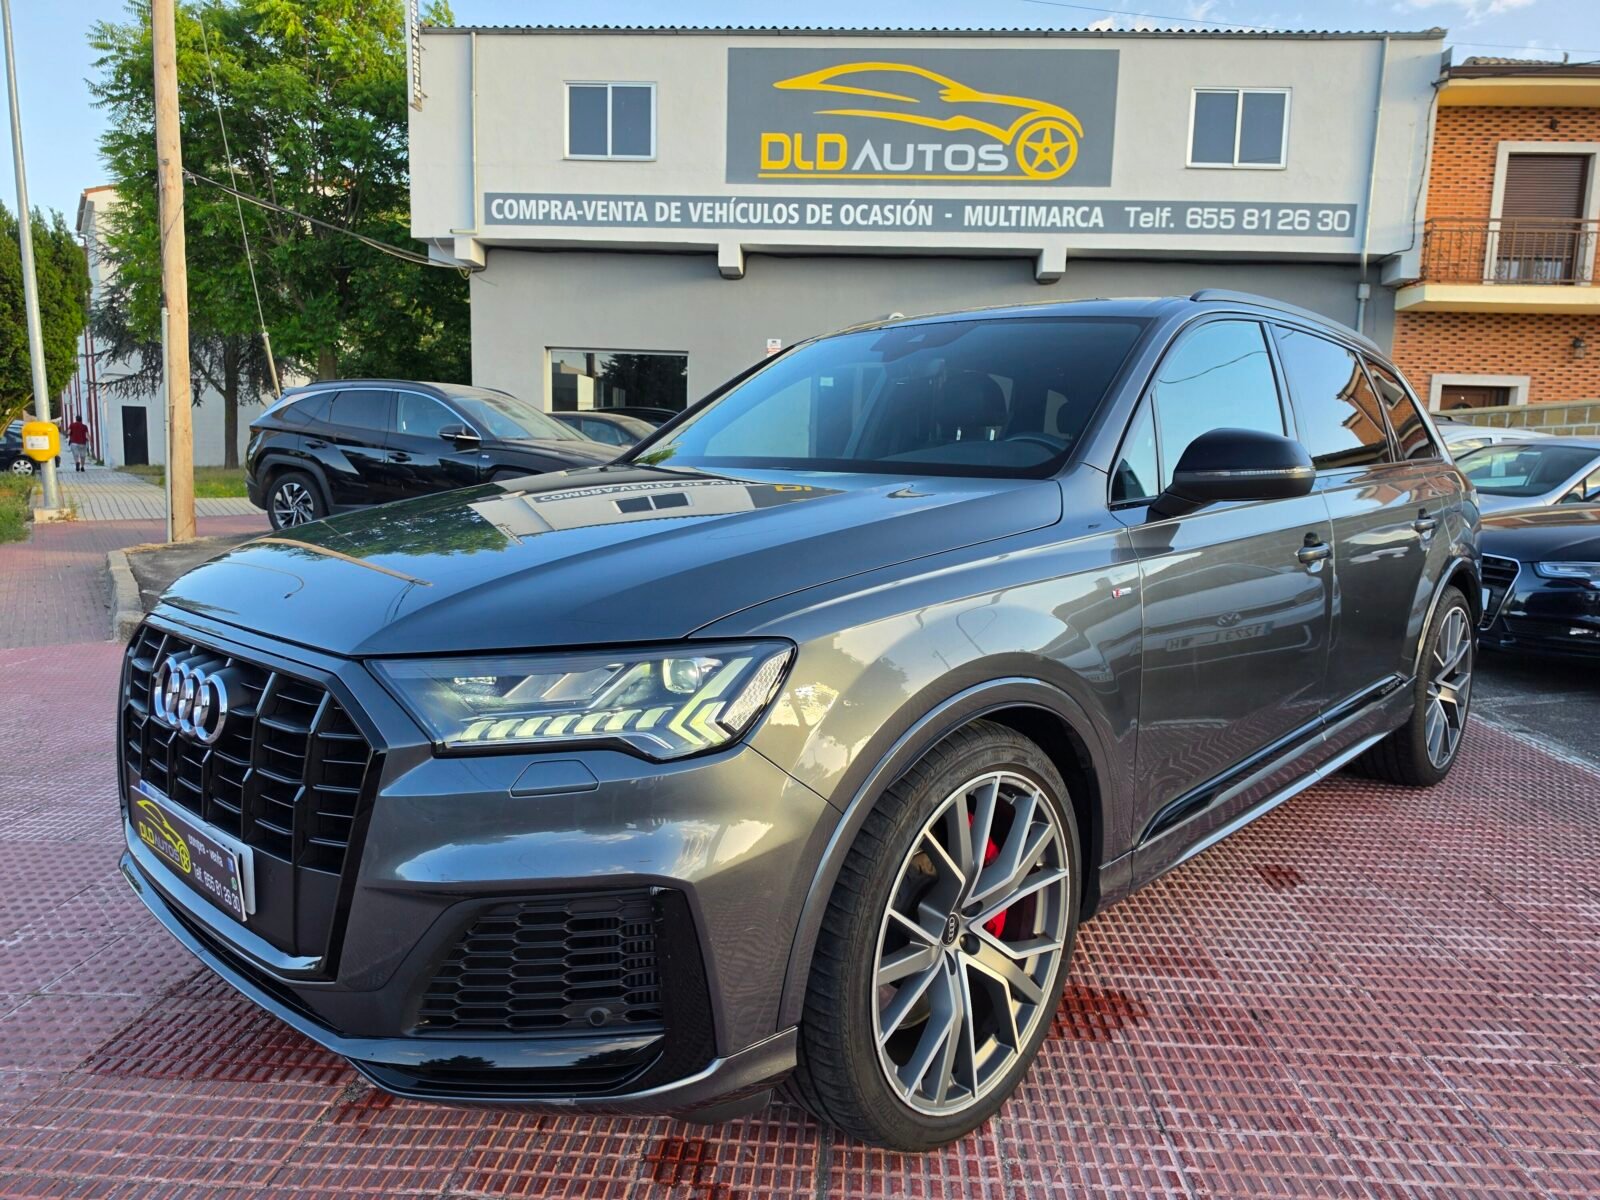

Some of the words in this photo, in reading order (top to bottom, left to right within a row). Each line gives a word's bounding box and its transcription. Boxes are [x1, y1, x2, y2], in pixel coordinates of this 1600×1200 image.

[760, 132, 847, 170] DLD
[852, 139, 1008, 171] AUTOS
[490, 198, 648, 222] COMPRA-VENTA
[655, 202, 681, 222] DE
[689, 197, 800, 224] VEHÍCULOS
[806, 204, 832, 225] DE
[839, 199, 933, 226] OCASIÓN
[963, 205, 1105, 228] MULTIMARCA
[1124, 207, 1174, 228] Telf.
[1186, 208, 1235, 229] 655
[1242, 209, 1271, 229] 81
[1276, 209, 1311, 230] 26
[1317, 210, 1350, 231] 30
[139, 821, 155, 845] DLD
